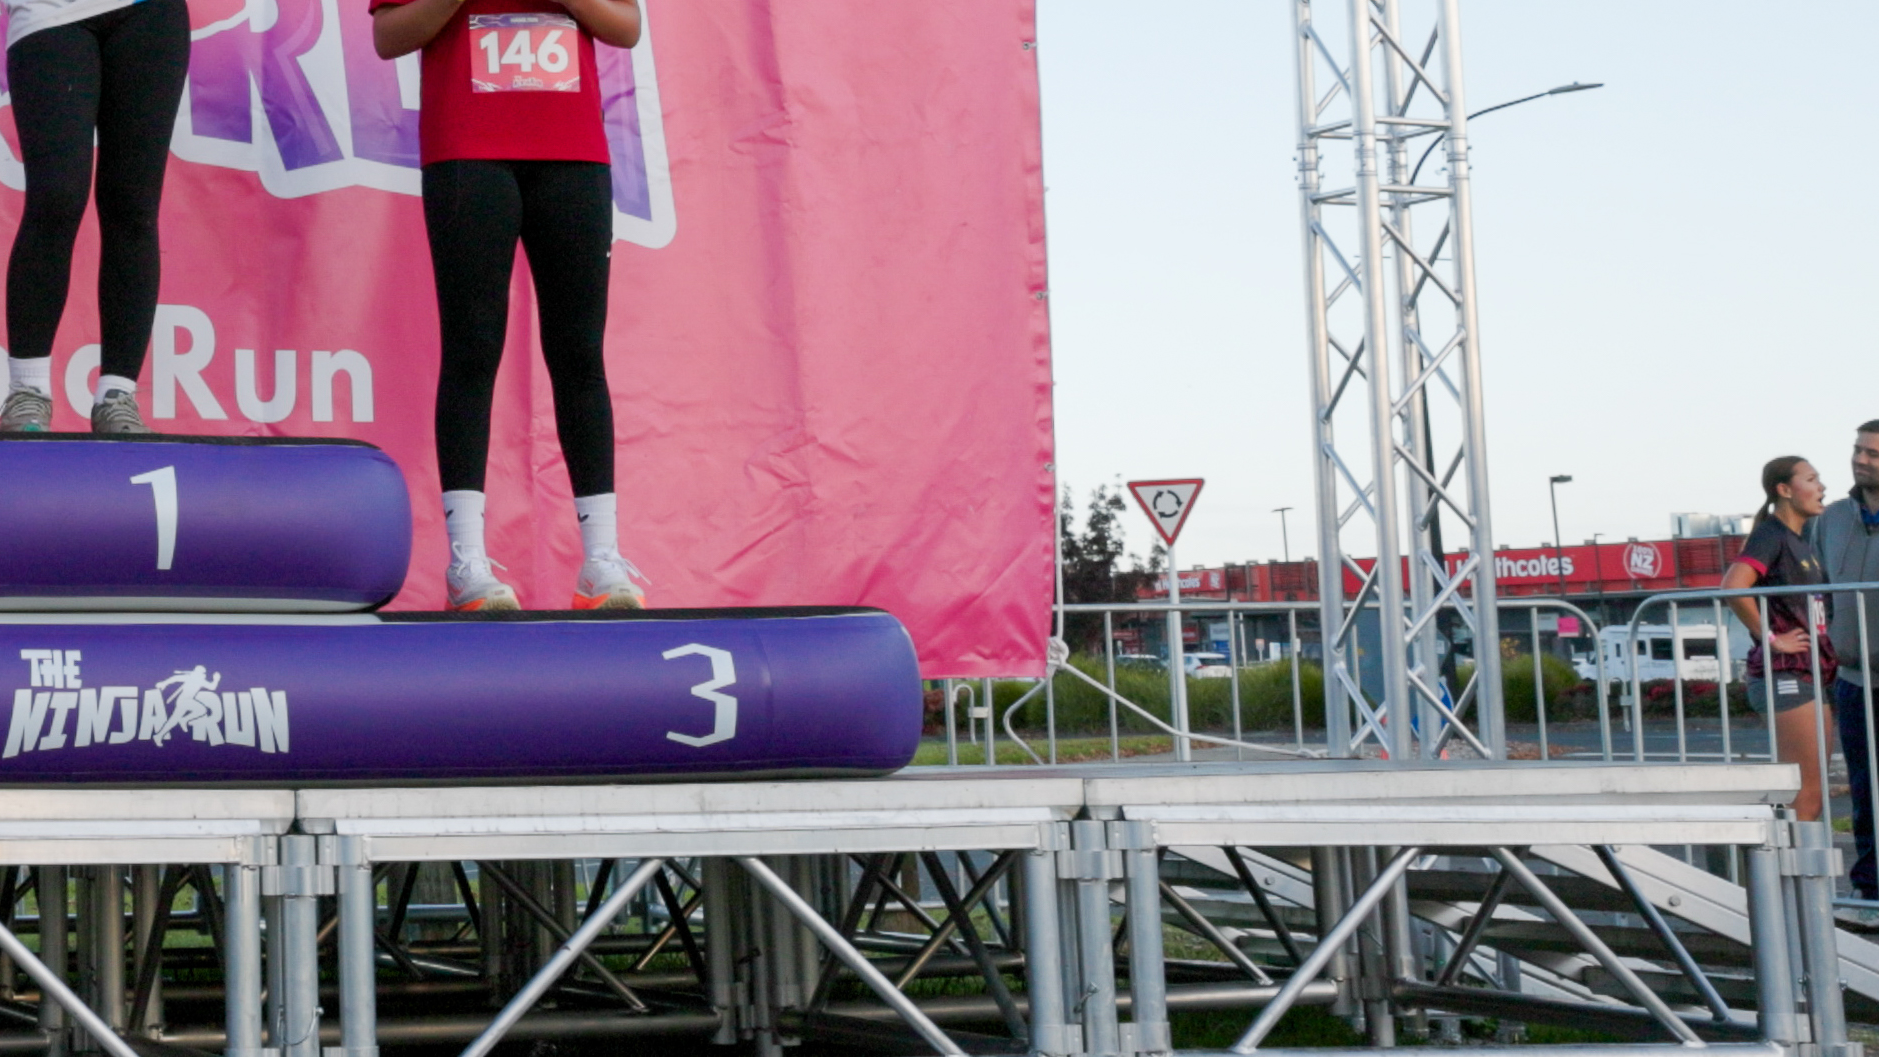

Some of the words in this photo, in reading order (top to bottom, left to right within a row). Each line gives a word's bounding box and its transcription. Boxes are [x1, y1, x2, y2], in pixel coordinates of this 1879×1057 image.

[480, 30, 569, 74] 146
[130, 466, 178, 570] 1
[1456, 554, 1574, 580] thcotes
[1631, 553, 1654, 568] NZ
[20, 649, 82, 689] THE
[661, 643, 738, 748] 3
[2, 686, 172, 759] NINJA
[192, 687, 290, 754] RUN
